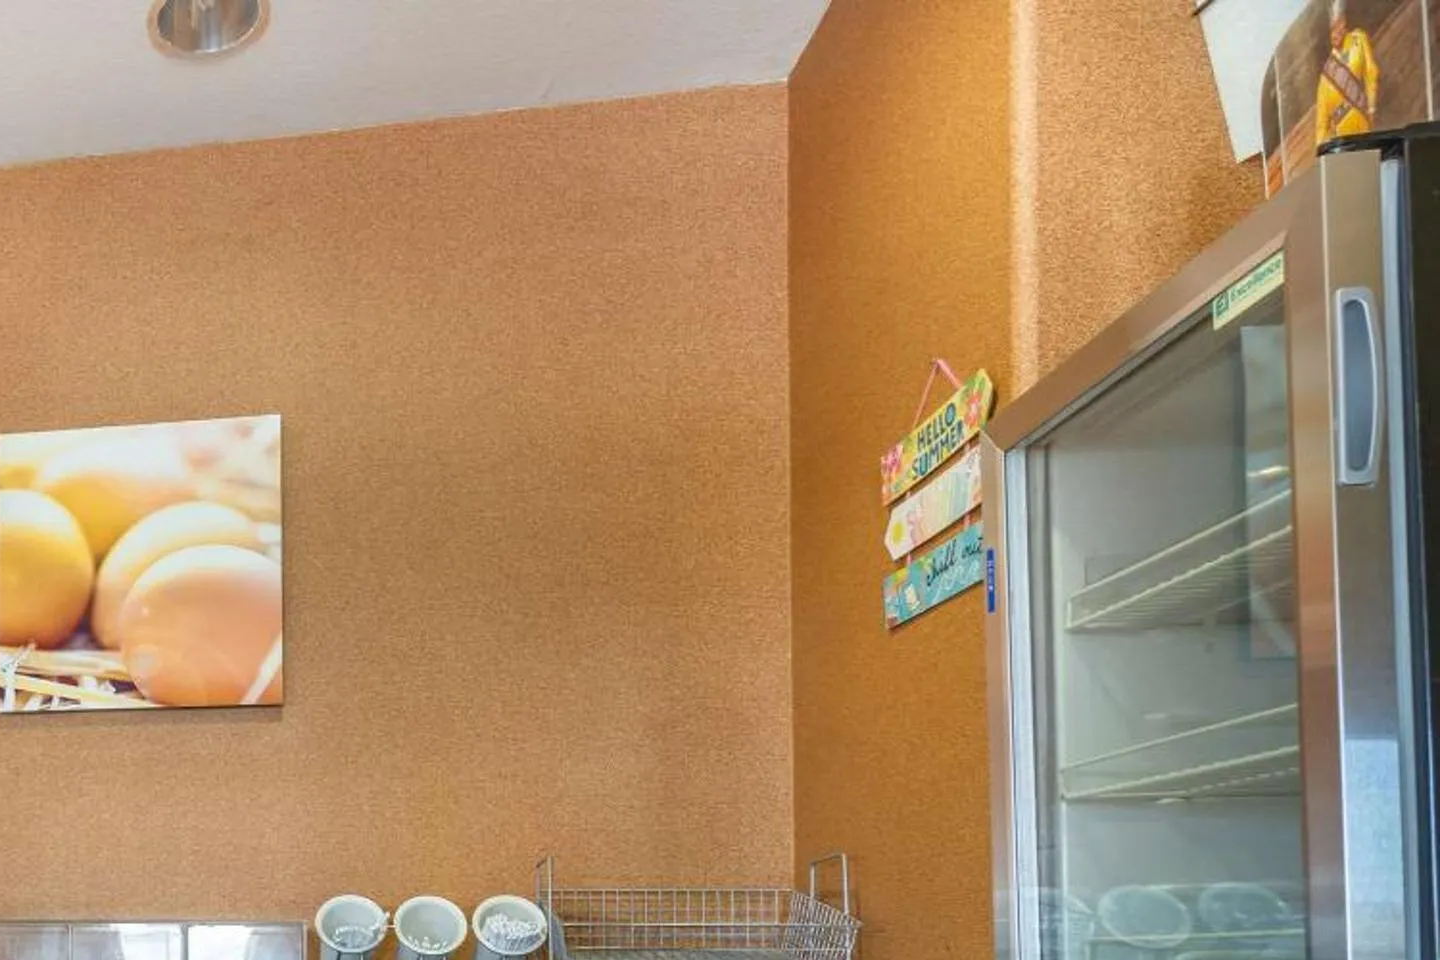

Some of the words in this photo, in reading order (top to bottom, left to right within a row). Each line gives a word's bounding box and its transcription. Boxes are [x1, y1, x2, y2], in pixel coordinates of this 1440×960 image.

[912, 419, 964, 480] SUMMER
[917, 402, 956, 451] HELLO
[926, 538, 957, 587] chill
